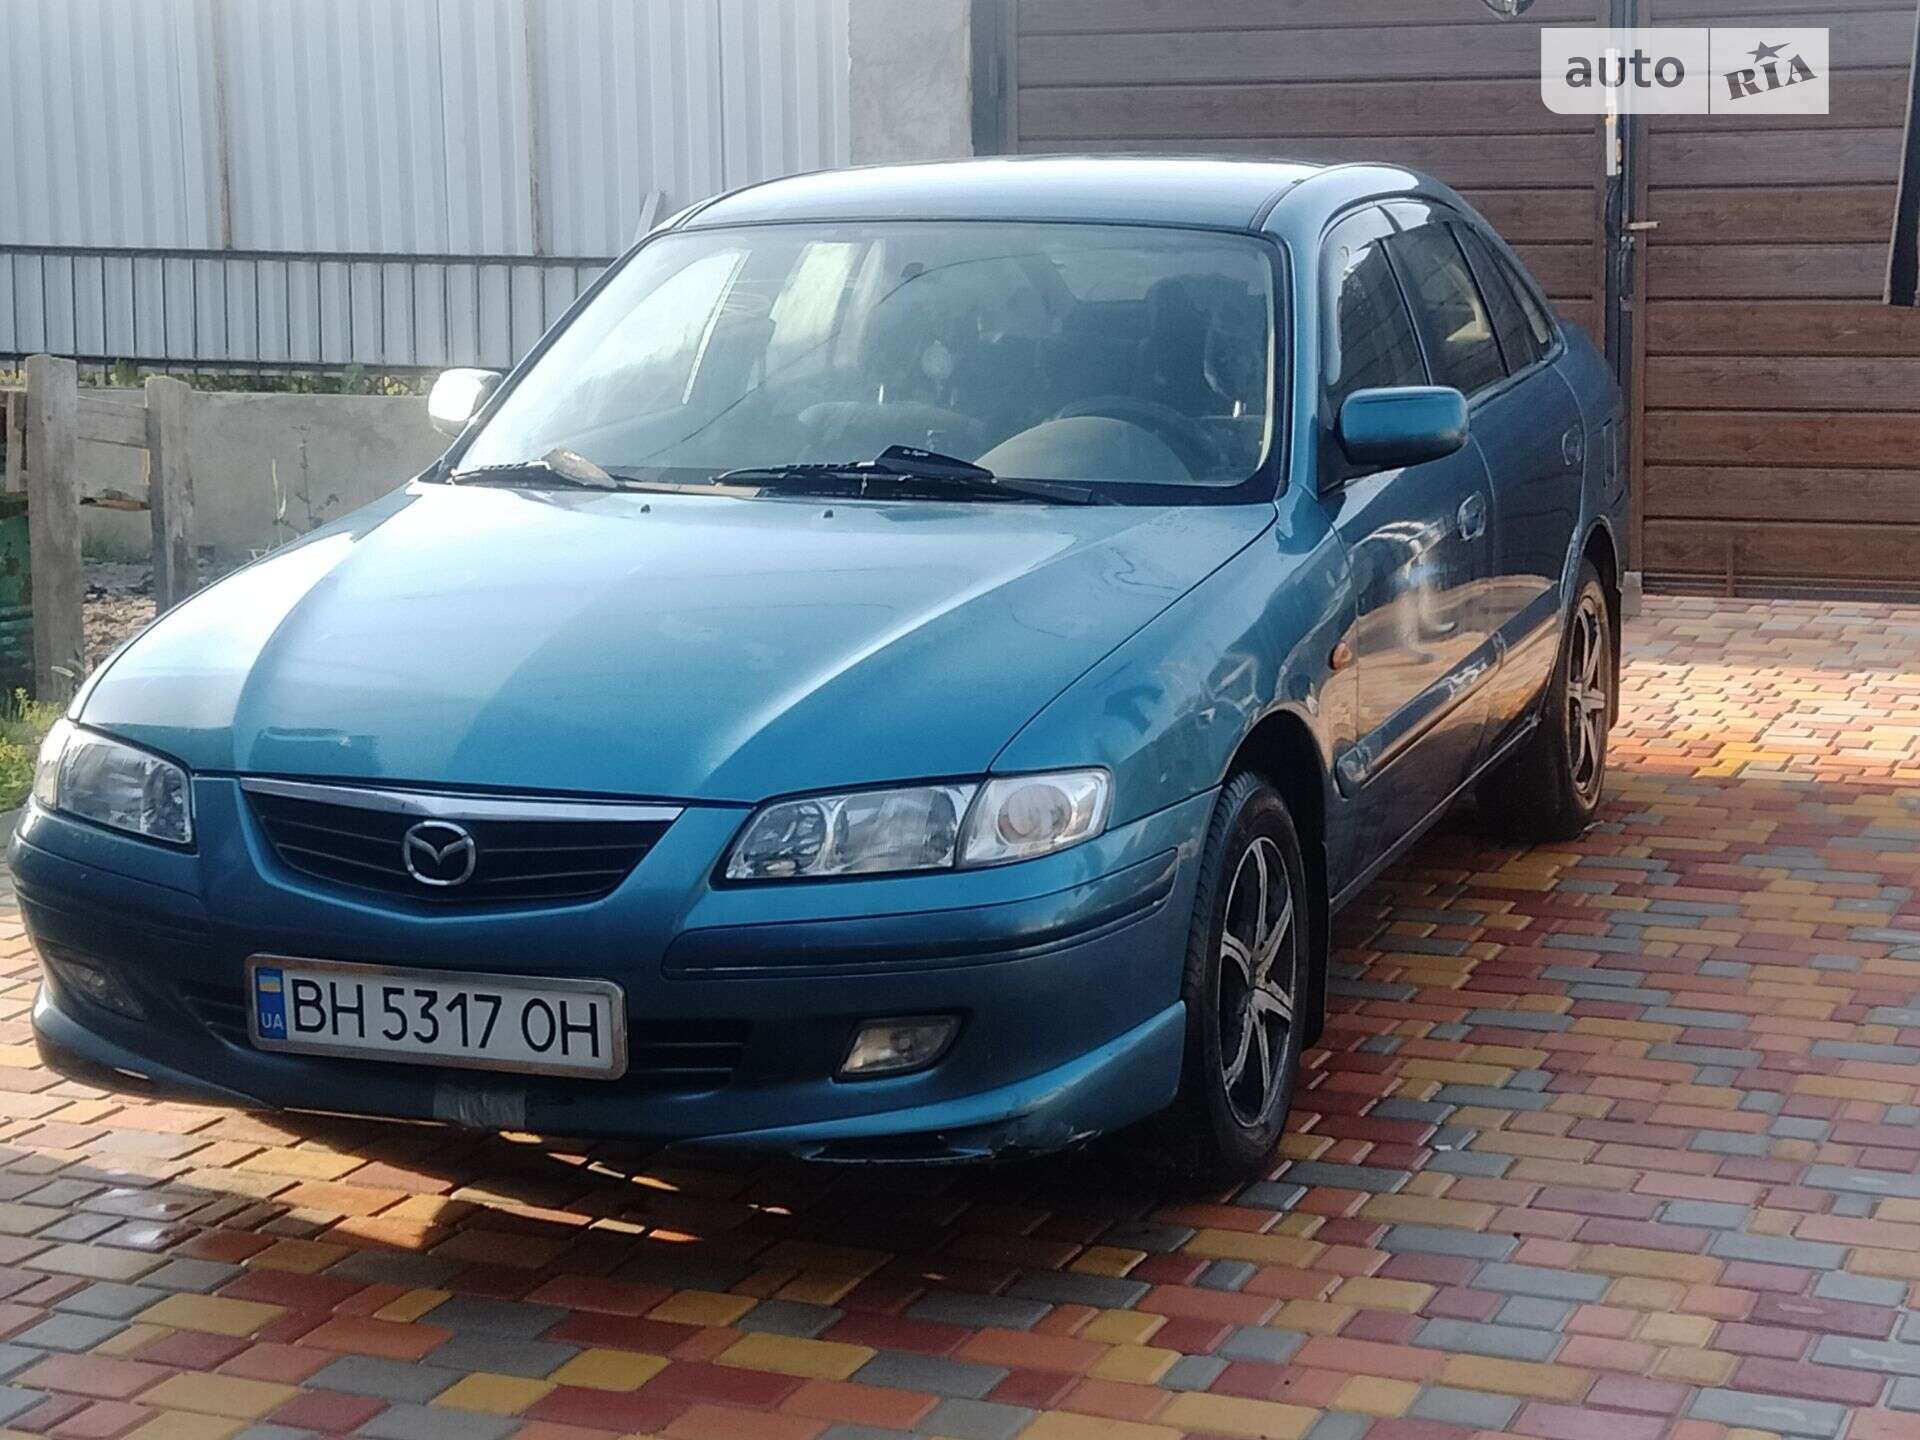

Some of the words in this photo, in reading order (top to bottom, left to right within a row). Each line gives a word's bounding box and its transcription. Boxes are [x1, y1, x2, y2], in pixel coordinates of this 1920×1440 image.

[260, 1011, 284, 1031] UA
[291, 978, 366, 1038] BH
[382, 986, 503, 1049] 5317
[521, 998, 600, 1057] OH
